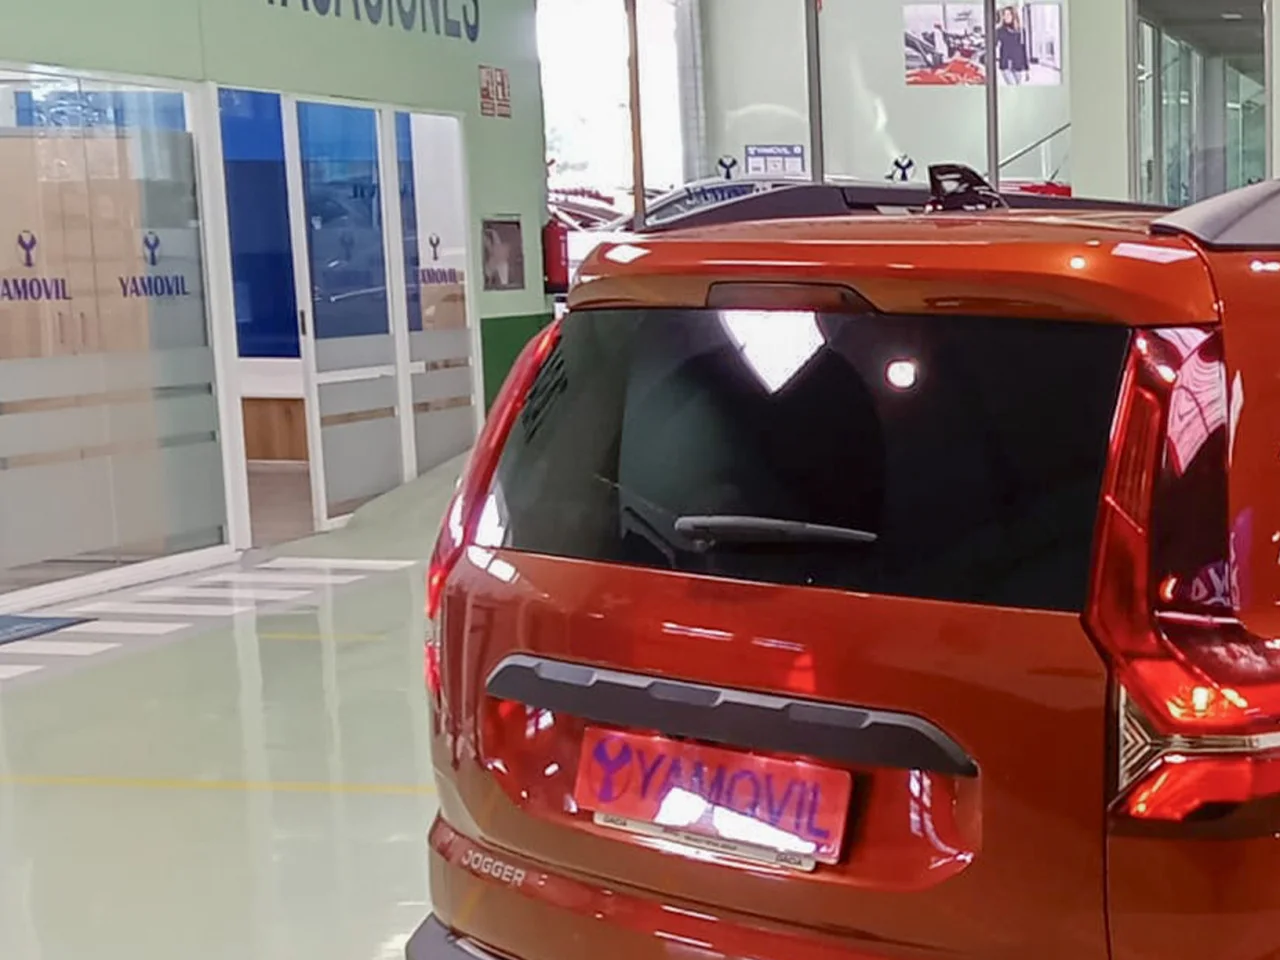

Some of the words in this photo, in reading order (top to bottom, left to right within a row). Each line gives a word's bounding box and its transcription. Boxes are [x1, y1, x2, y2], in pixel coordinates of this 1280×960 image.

[0, 277, 73, 301] AMOVIL
[118, 275, 190, 298] YAMOVIL
[634, 751, 830, 838] YAMOVIL
[461, 849, 527, 887] JOGGER
